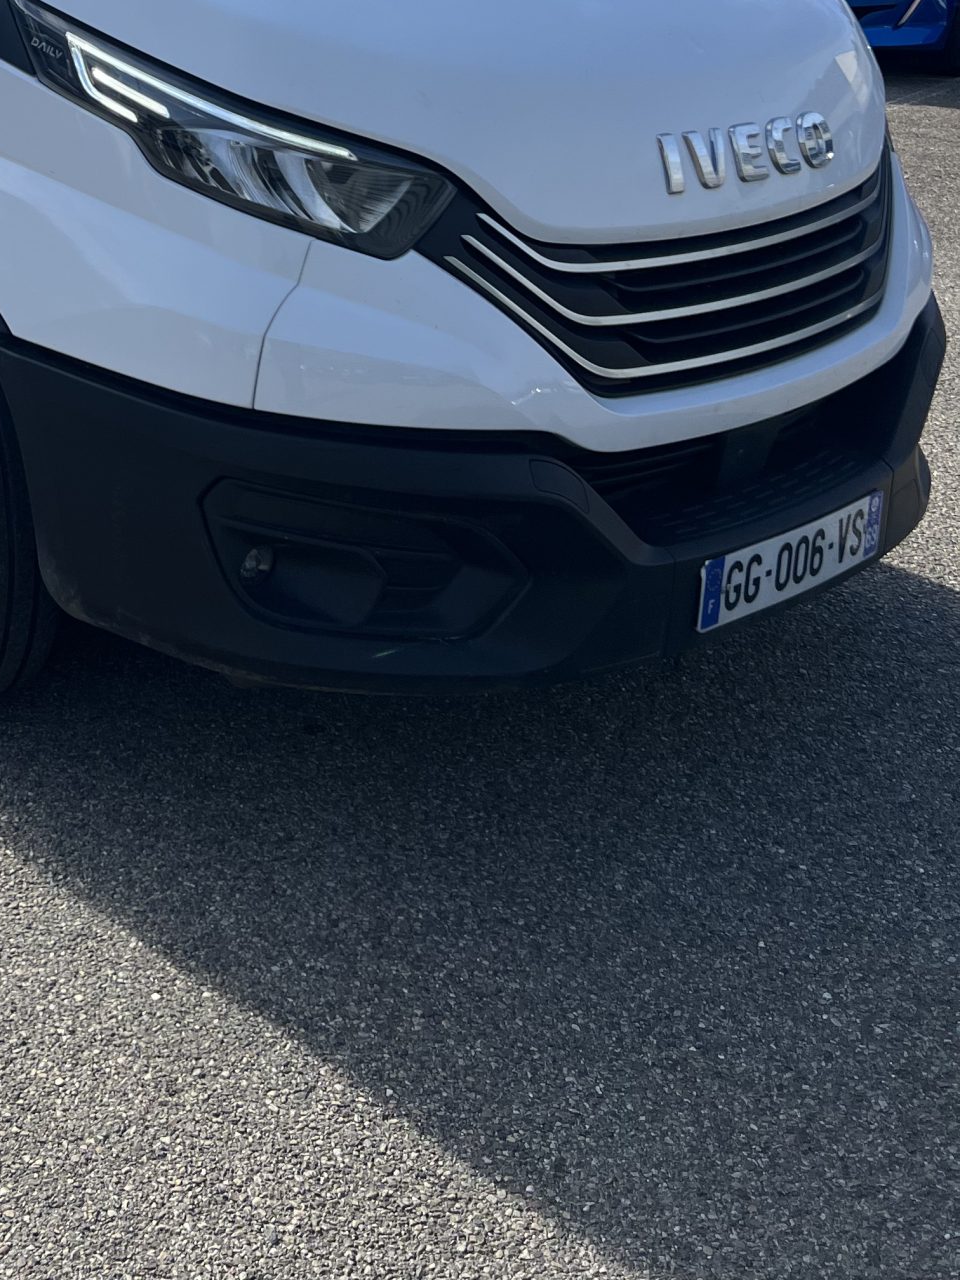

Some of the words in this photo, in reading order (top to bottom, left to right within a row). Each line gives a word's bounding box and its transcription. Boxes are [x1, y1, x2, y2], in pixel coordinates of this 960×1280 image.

[30, 36, 63, 59] DAILY
[656, 111, 834, 195] IVECO
[724, 508, 865, 612] GG-006-VS
[707, 599, 716, 614] F
